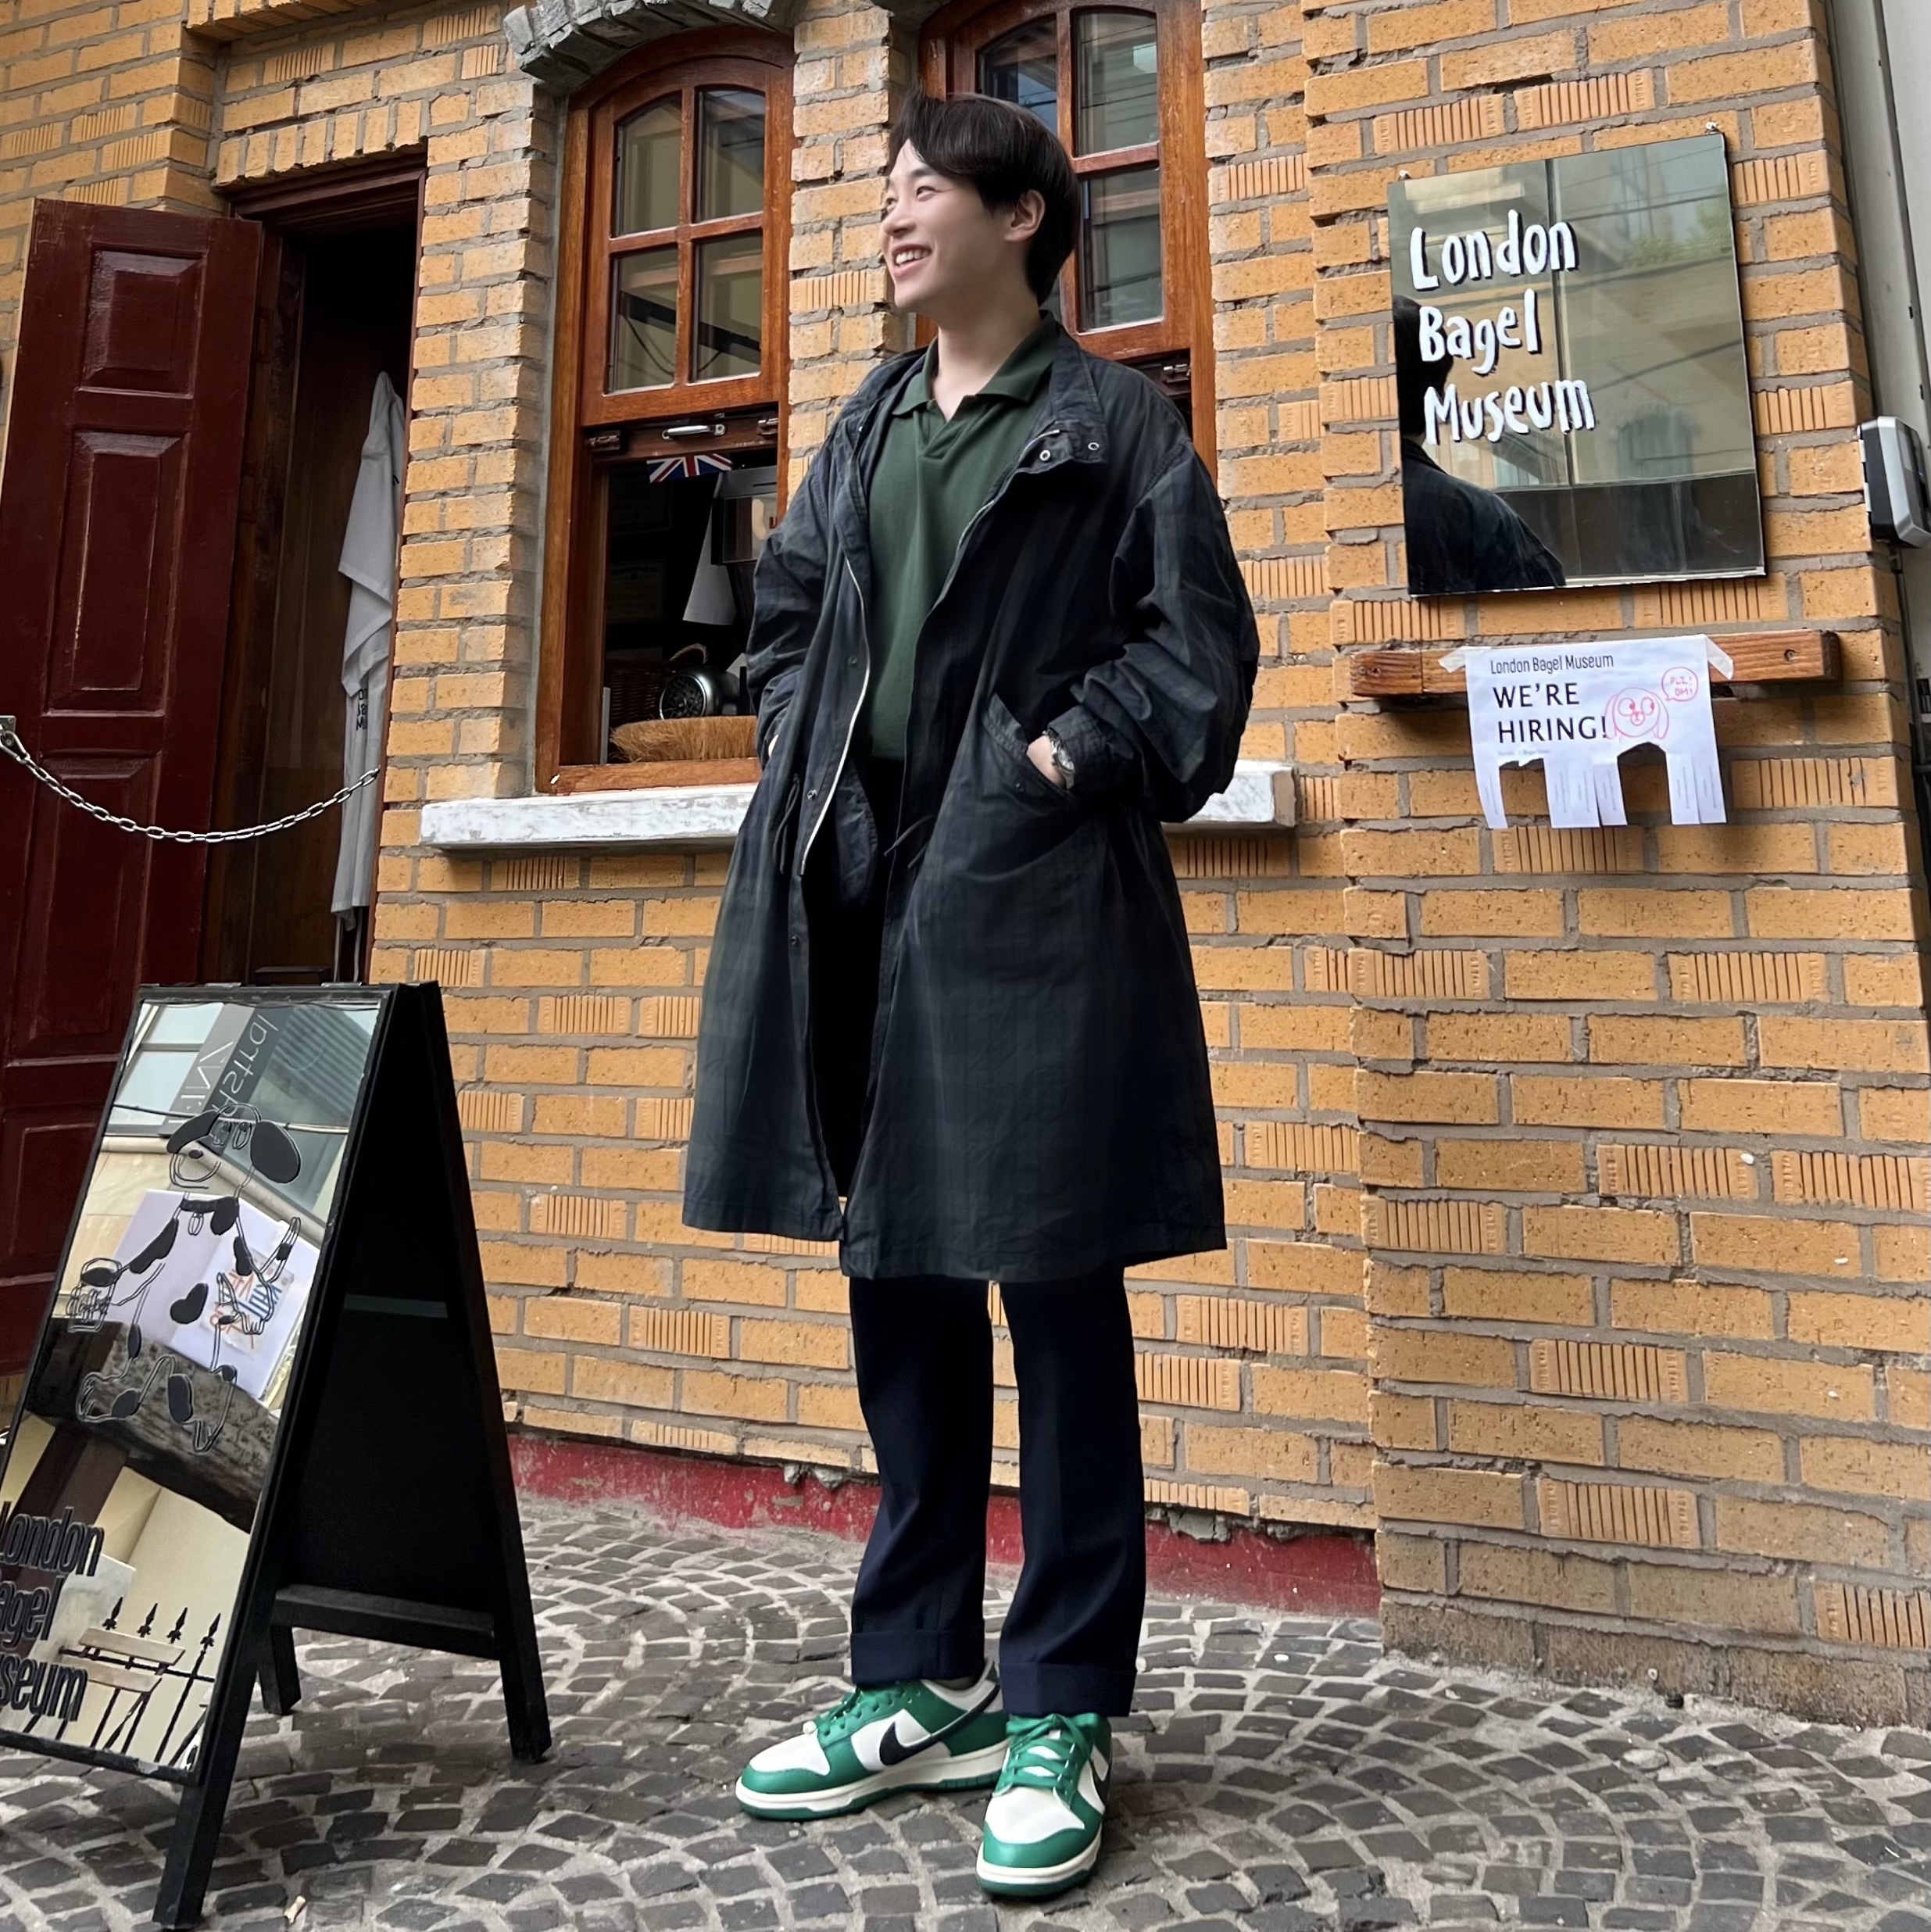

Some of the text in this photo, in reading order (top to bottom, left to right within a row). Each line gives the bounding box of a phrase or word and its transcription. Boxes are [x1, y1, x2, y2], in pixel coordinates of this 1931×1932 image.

[1410, 209, 1579, 291] London
[1418, 288, 1542, 375] Bagel
[1424, 379, 1597, 445] Museum
[1490, 654, 1615, 674] London Bagel Museum
[1493, 683, 1580, 709] WE'RE
[1498, 716, 1607, 744] HIRING!
[0, 1575, 66, 1649] agel
[0, 1654, 88, 1722] seum
